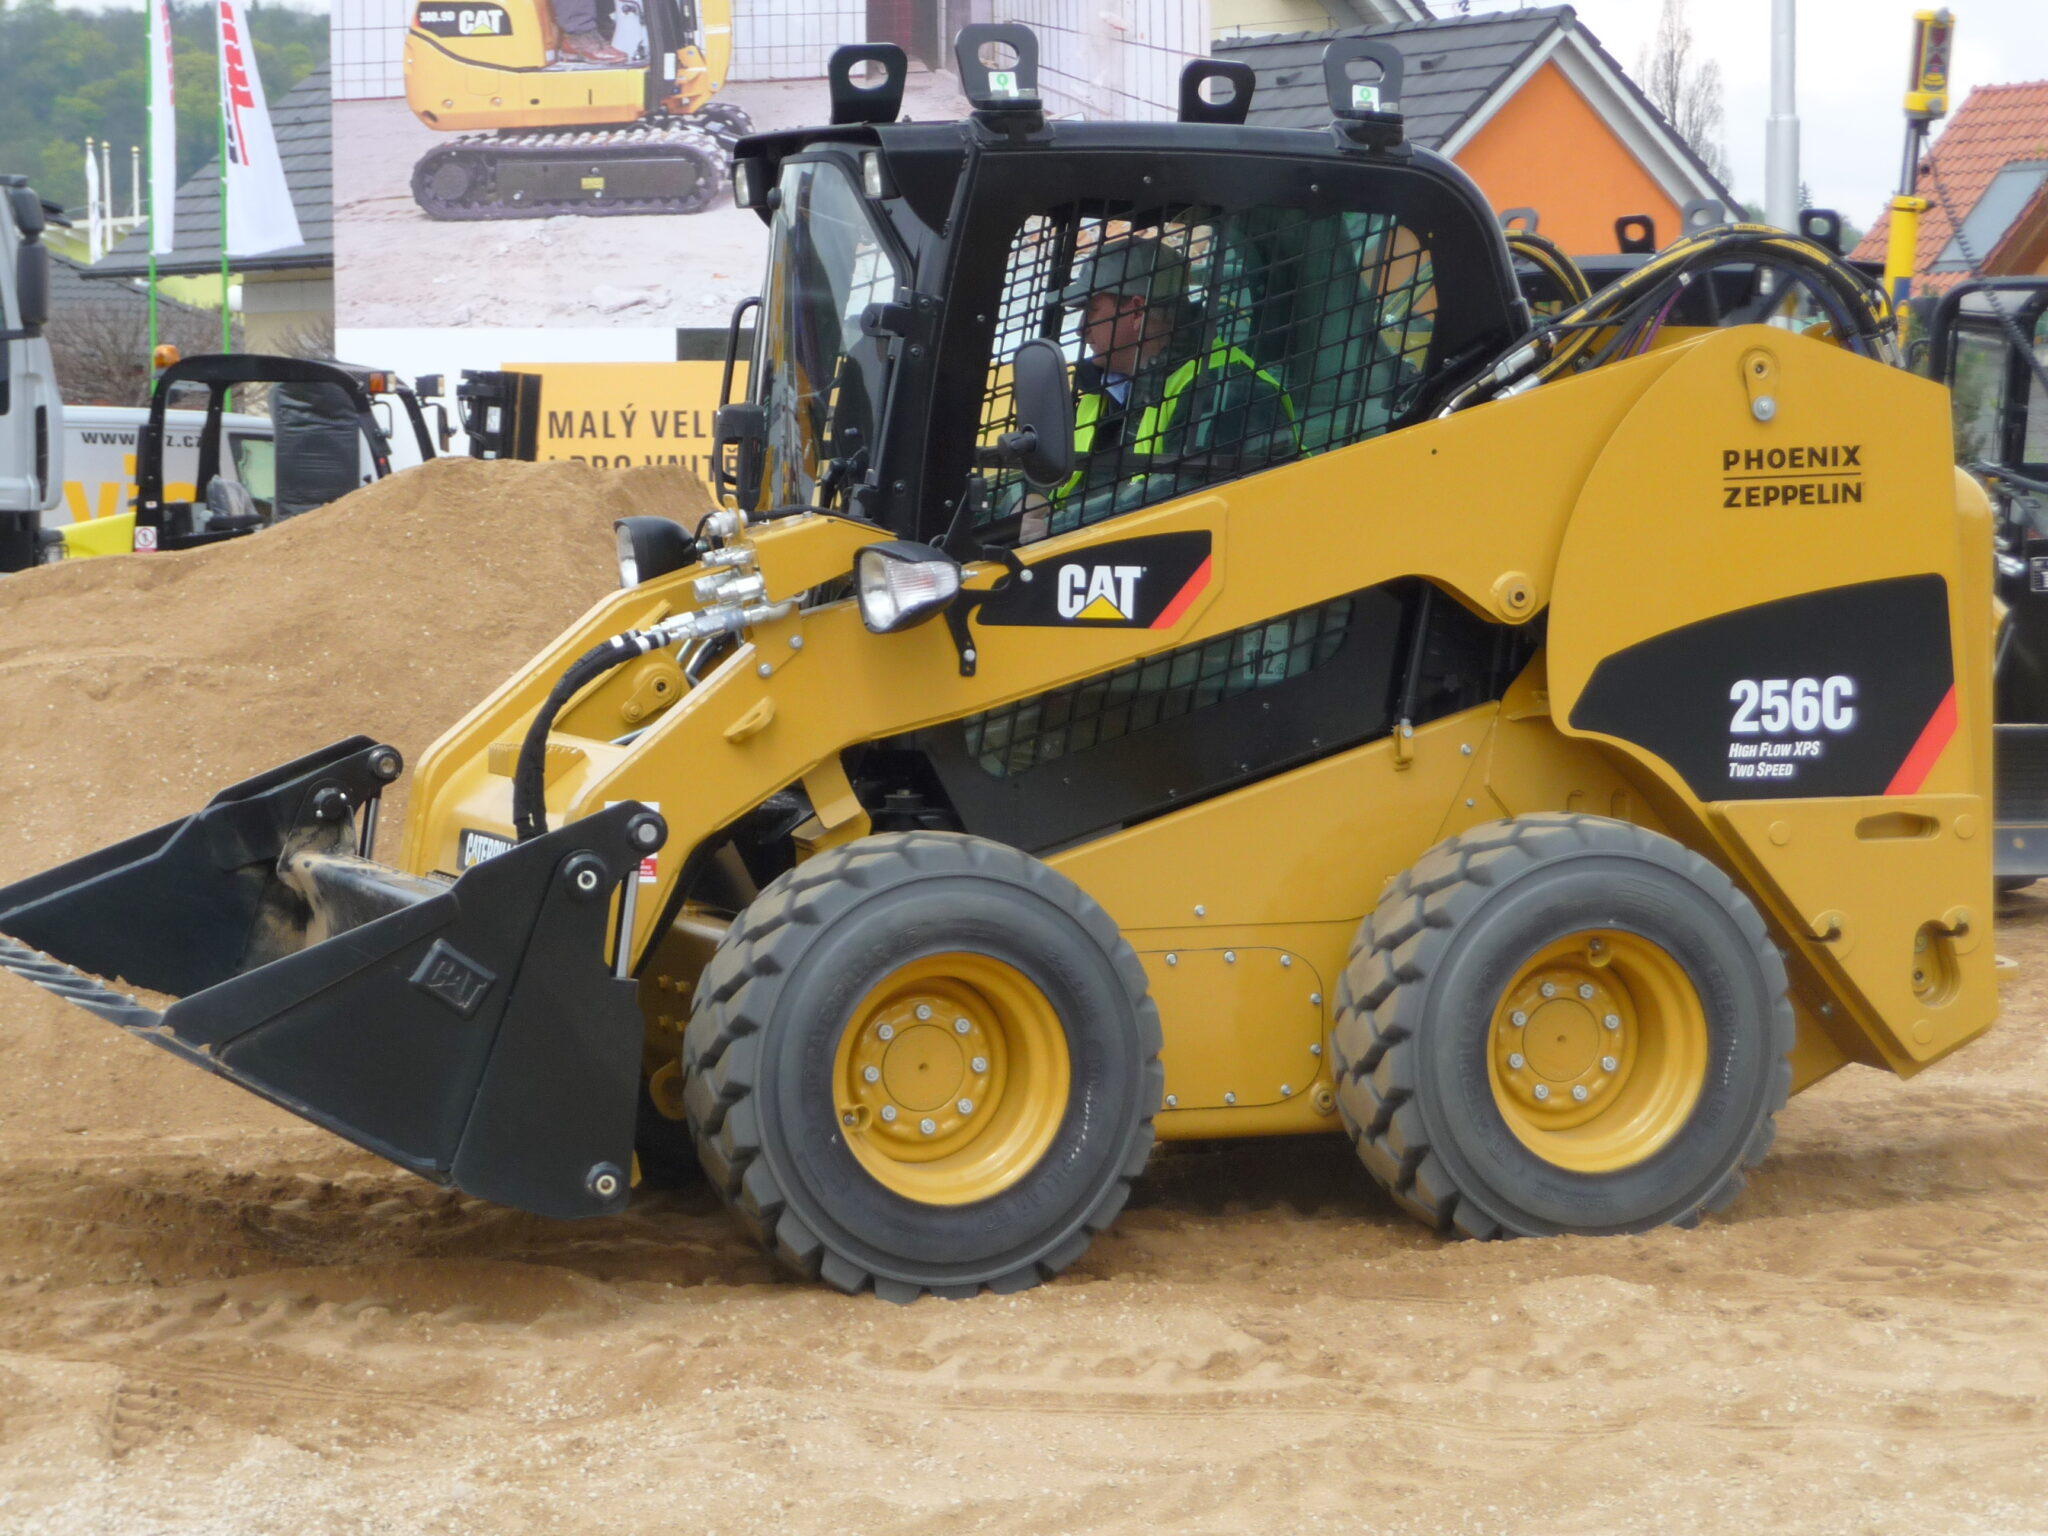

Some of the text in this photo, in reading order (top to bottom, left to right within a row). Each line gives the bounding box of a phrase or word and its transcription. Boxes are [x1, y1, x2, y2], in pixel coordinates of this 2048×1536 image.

[459, 10, 504, 34] CAT
[548, 403, 637, 438] MALÝ
[1723, 445, 1861, 471] PHOENIX
[1723, 482, 1862, 508] ZEPPELIN
[1057, 564, 1141, 619] CAT
[1729, 675, 1853, 732] 256C
[1793, 740, 1820, 756] XPS
